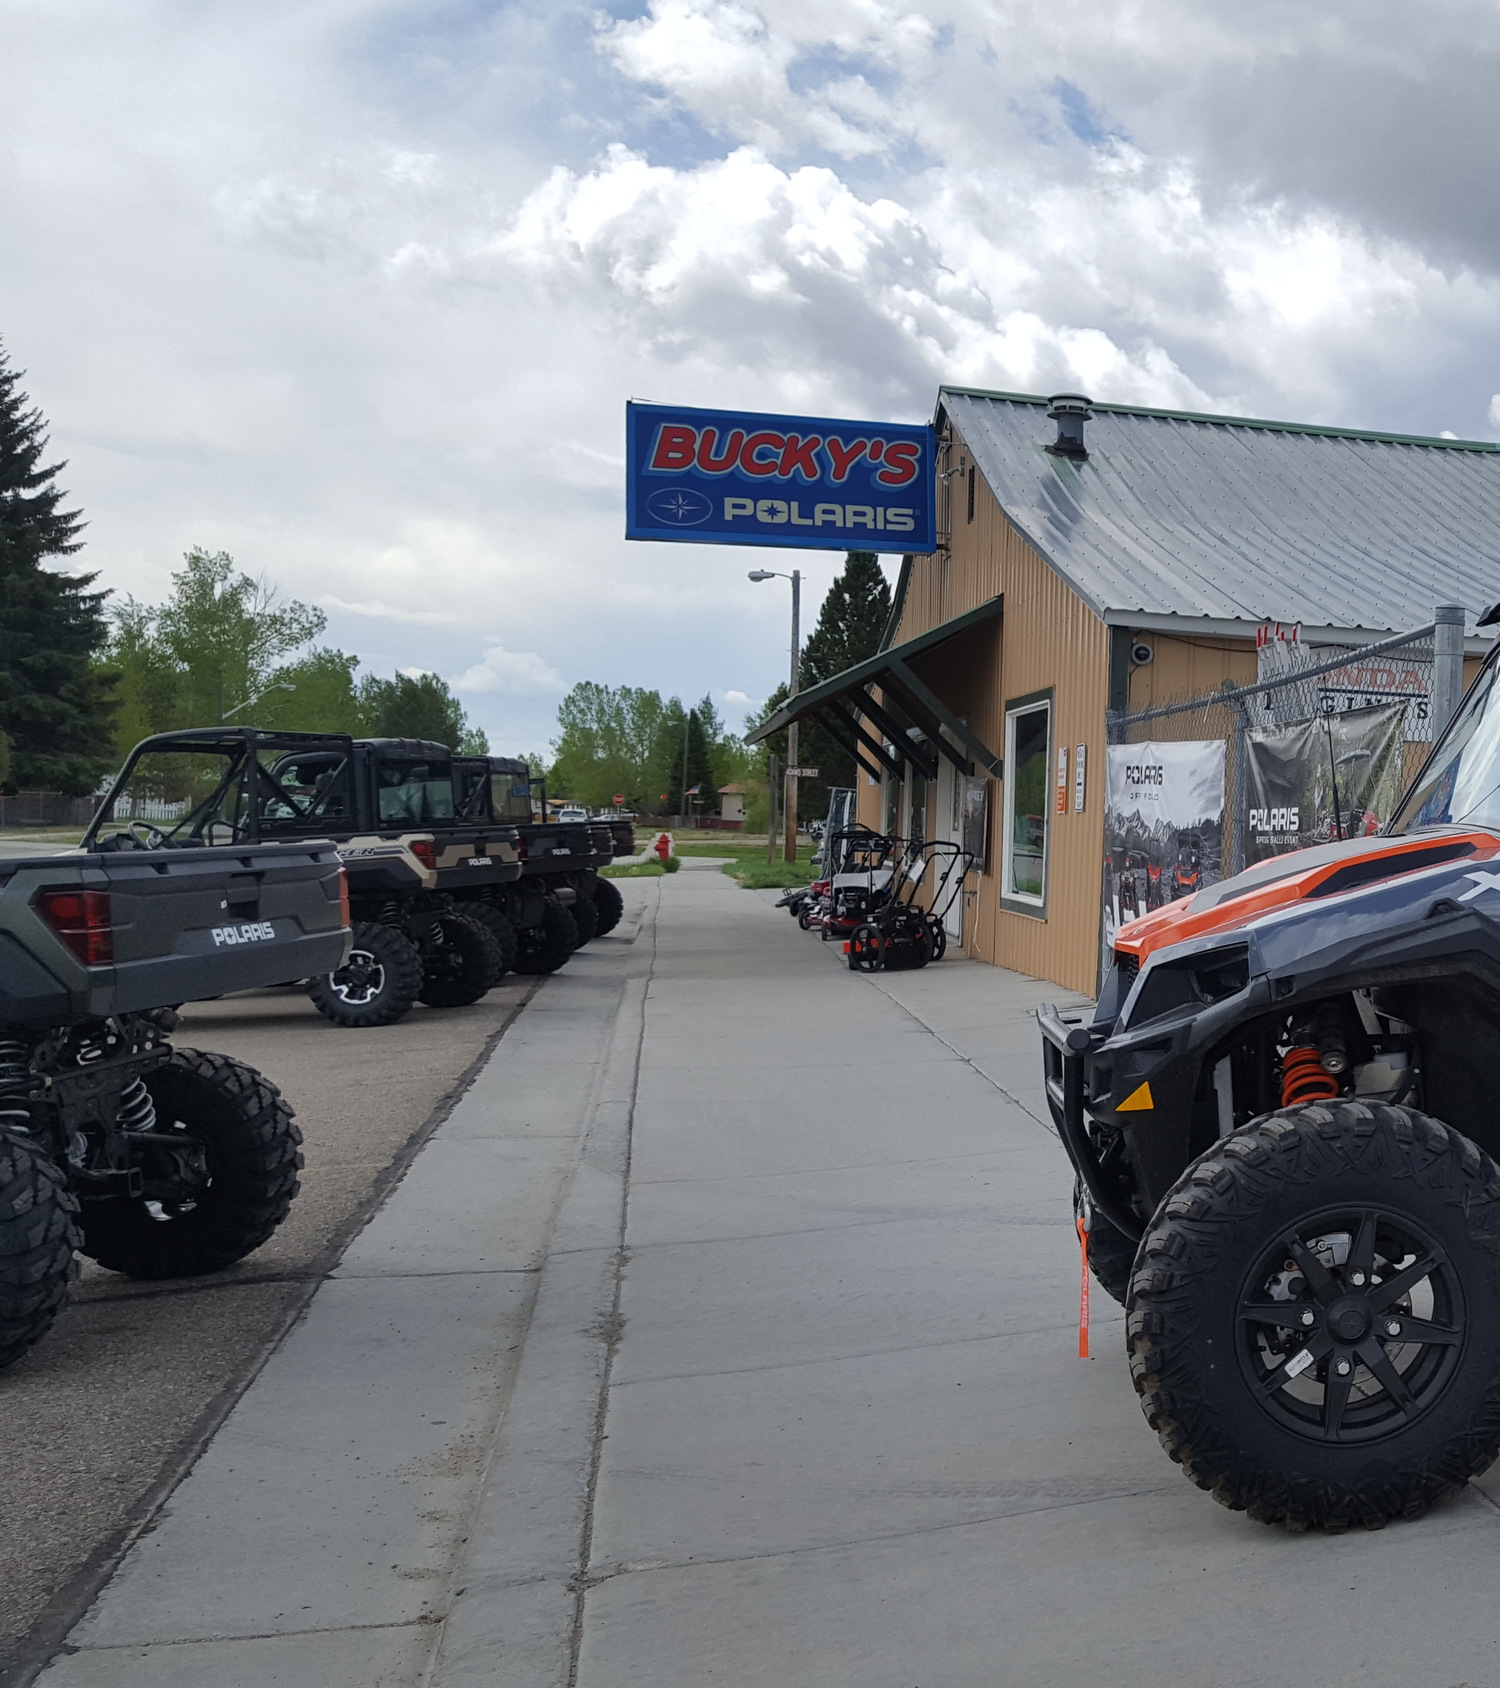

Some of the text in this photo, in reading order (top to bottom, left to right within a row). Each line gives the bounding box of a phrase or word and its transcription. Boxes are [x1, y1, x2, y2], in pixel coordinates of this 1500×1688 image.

[648, 424, 920, 487] BUCKY'S
[724, 497, 915, 531] POLARIS
[1125, 765, 1163, 785] POLARIS
[1249, 807, 1299, 831] POLARIS
[468, 857, 492, 866] POLARIS
[211, 921, 275, 946] POLARIS
[1081, 1265, 1089, 1329] POLARIS
